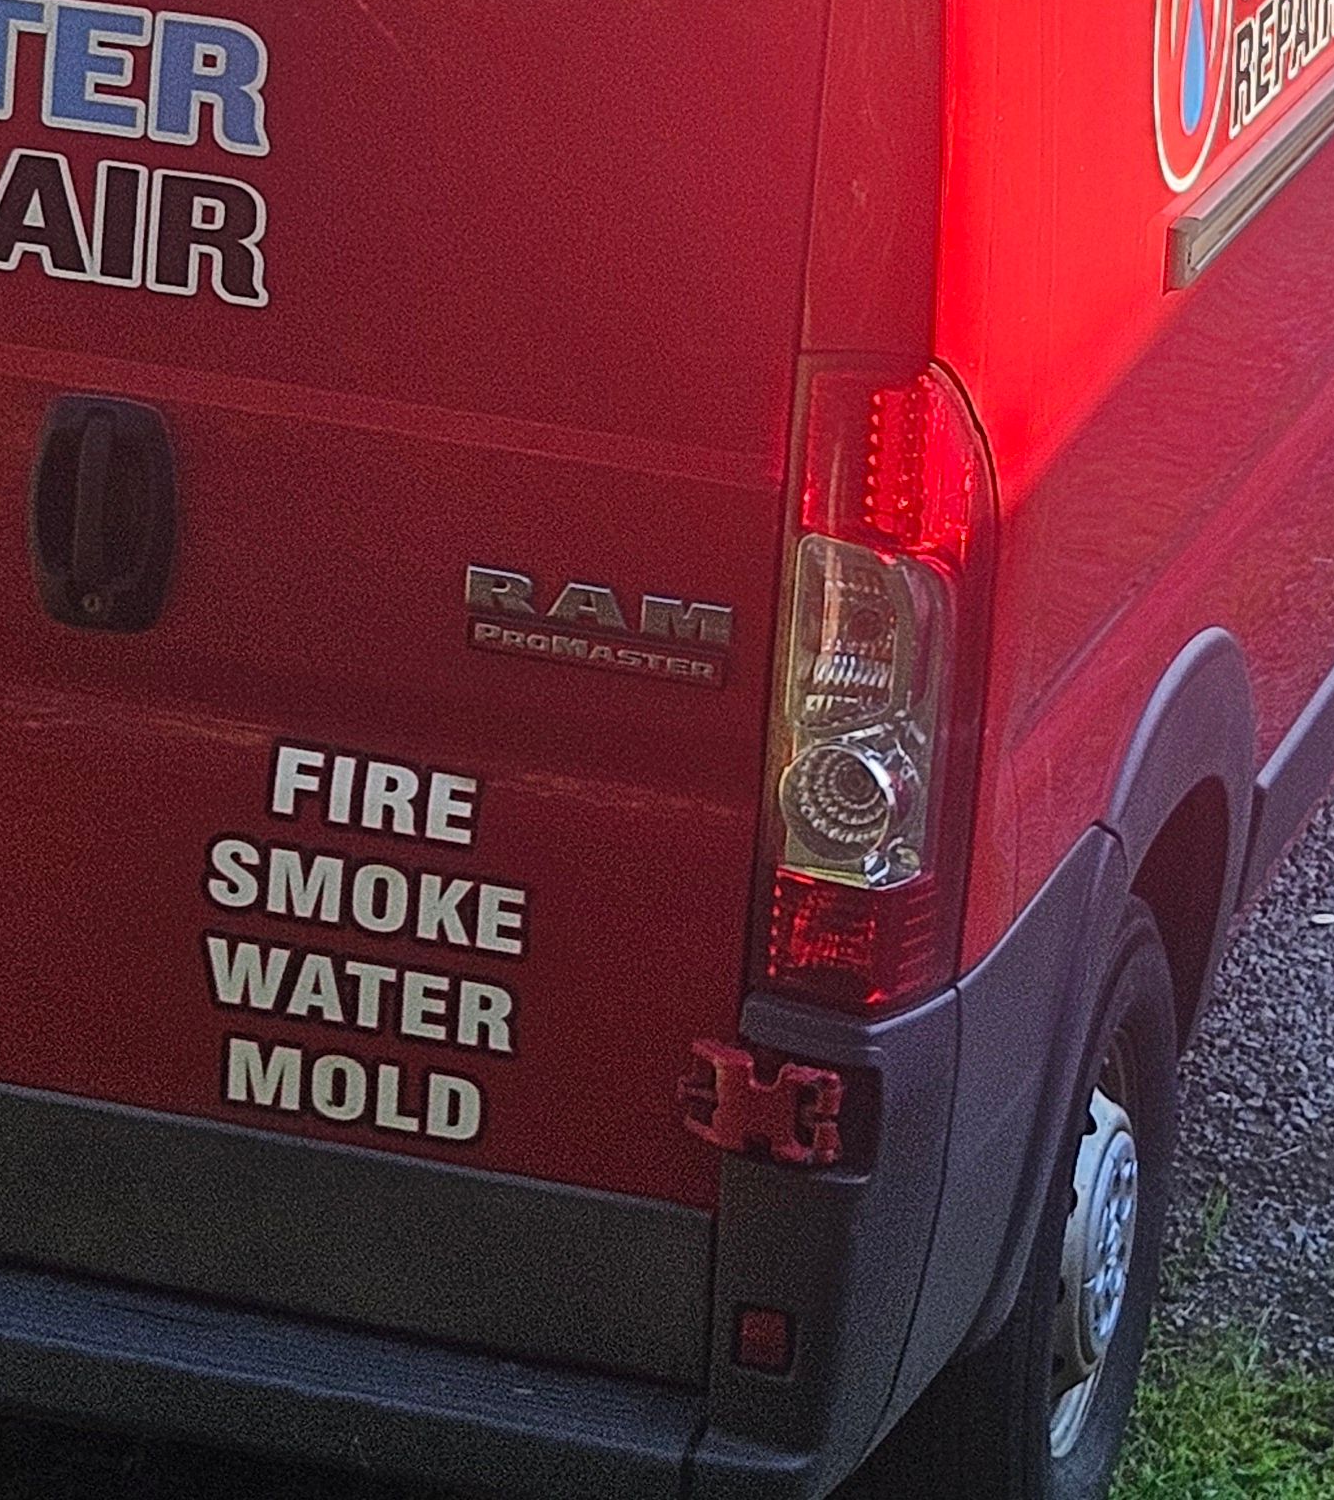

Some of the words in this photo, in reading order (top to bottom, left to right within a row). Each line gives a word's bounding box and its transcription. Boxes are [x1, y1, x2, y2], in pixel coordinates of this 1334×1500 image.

[465, 563, 735, 646] RAM
[270, 745, 479, 845] FIRE
[206, 838, 527, 956] SMOKE
[205, 935, 514, 1054] WATER
[225, 1036, 482, 1142] MOLD
